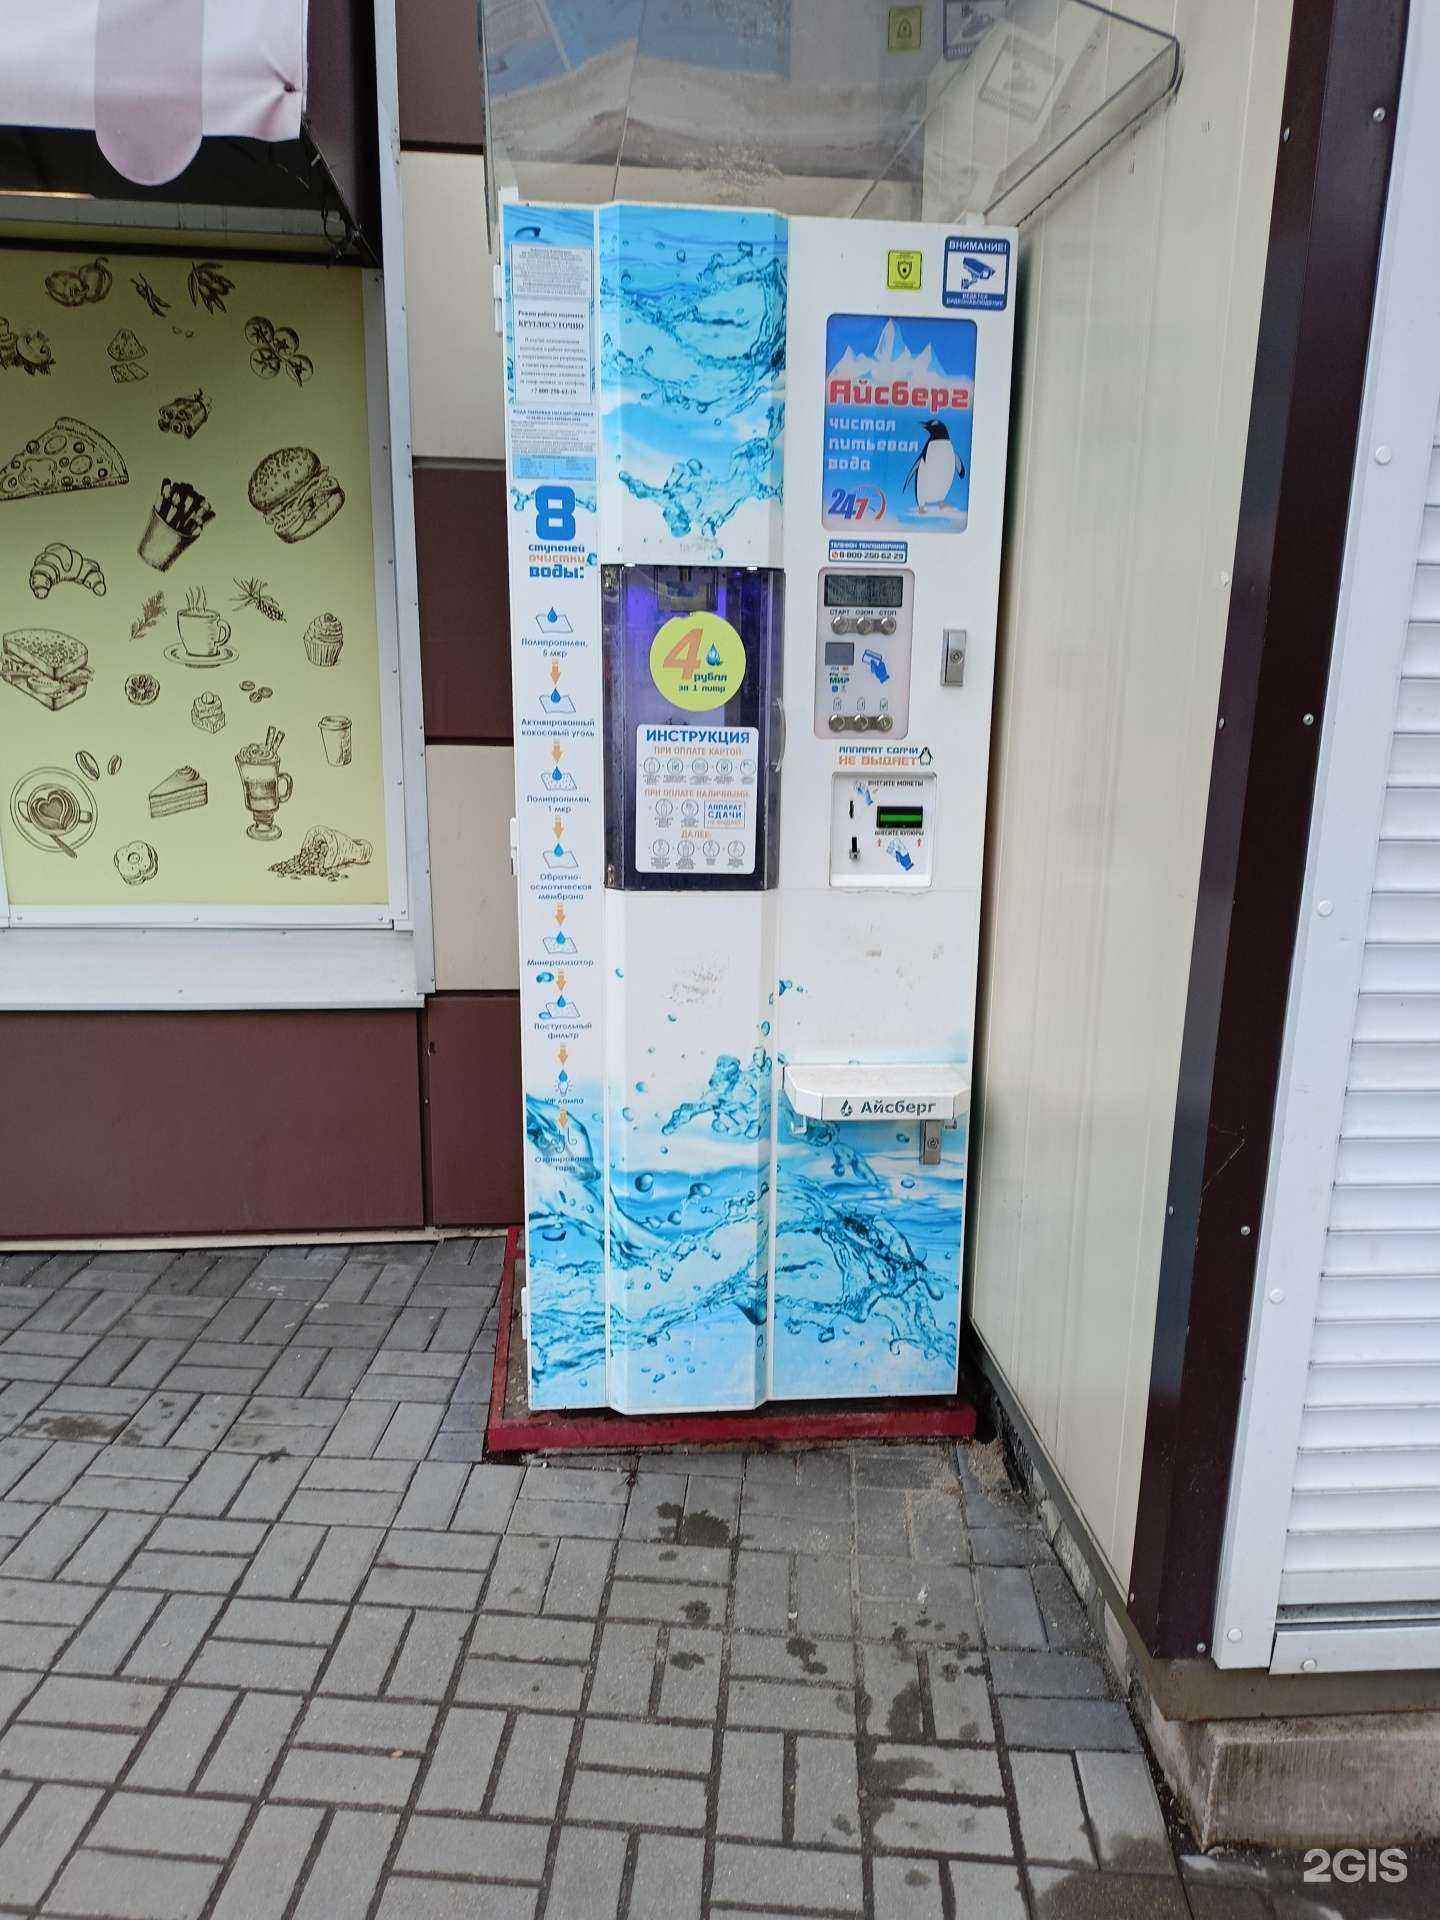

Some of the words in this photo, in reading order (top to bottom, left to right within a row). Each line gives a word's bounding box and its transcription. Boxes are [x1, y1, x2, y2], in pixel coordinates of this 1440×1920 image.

[949, 240, 1007, 252] ВНИМАНИЕ!
[829, 379, 969, 412] Айсберг
[828, 417, 897, 432] чистая
[828, 437, 920, 452] питьевая
[827, 456, 871, 471] вода
[535, 486, 576, 541] 8
[528, 543, 586, 553] ступеней
[528, 554, 586, 564] очистки
[529, 563, 585, 579] воды:
[829, 608, 850, 616] СТАРТ
[662, 627, 704, 681] 4
[646, 729, 750, 745] ИНСТРУКЦИЯ
[654, 746, 671, 755] ПРИ
[674, 746, 705, 756] ОПЛАТЕ
[839, 745, 883, 754] АППАРАТ
[886, 745, 919, 754] СДАЧИ
[839, 755, 856, 766] НЕ
[861, 756, 917, 767] ВЫДАЕТ
[708, 810, 743, 819] СДАЧИ
[526, 959, 594, 968] Минерализатор
[534, 1022, 592, 1031] Постугольный
[547, 1032, 579, 1041] фильтр
[860, 1100, 937, 1116] Айсберг
